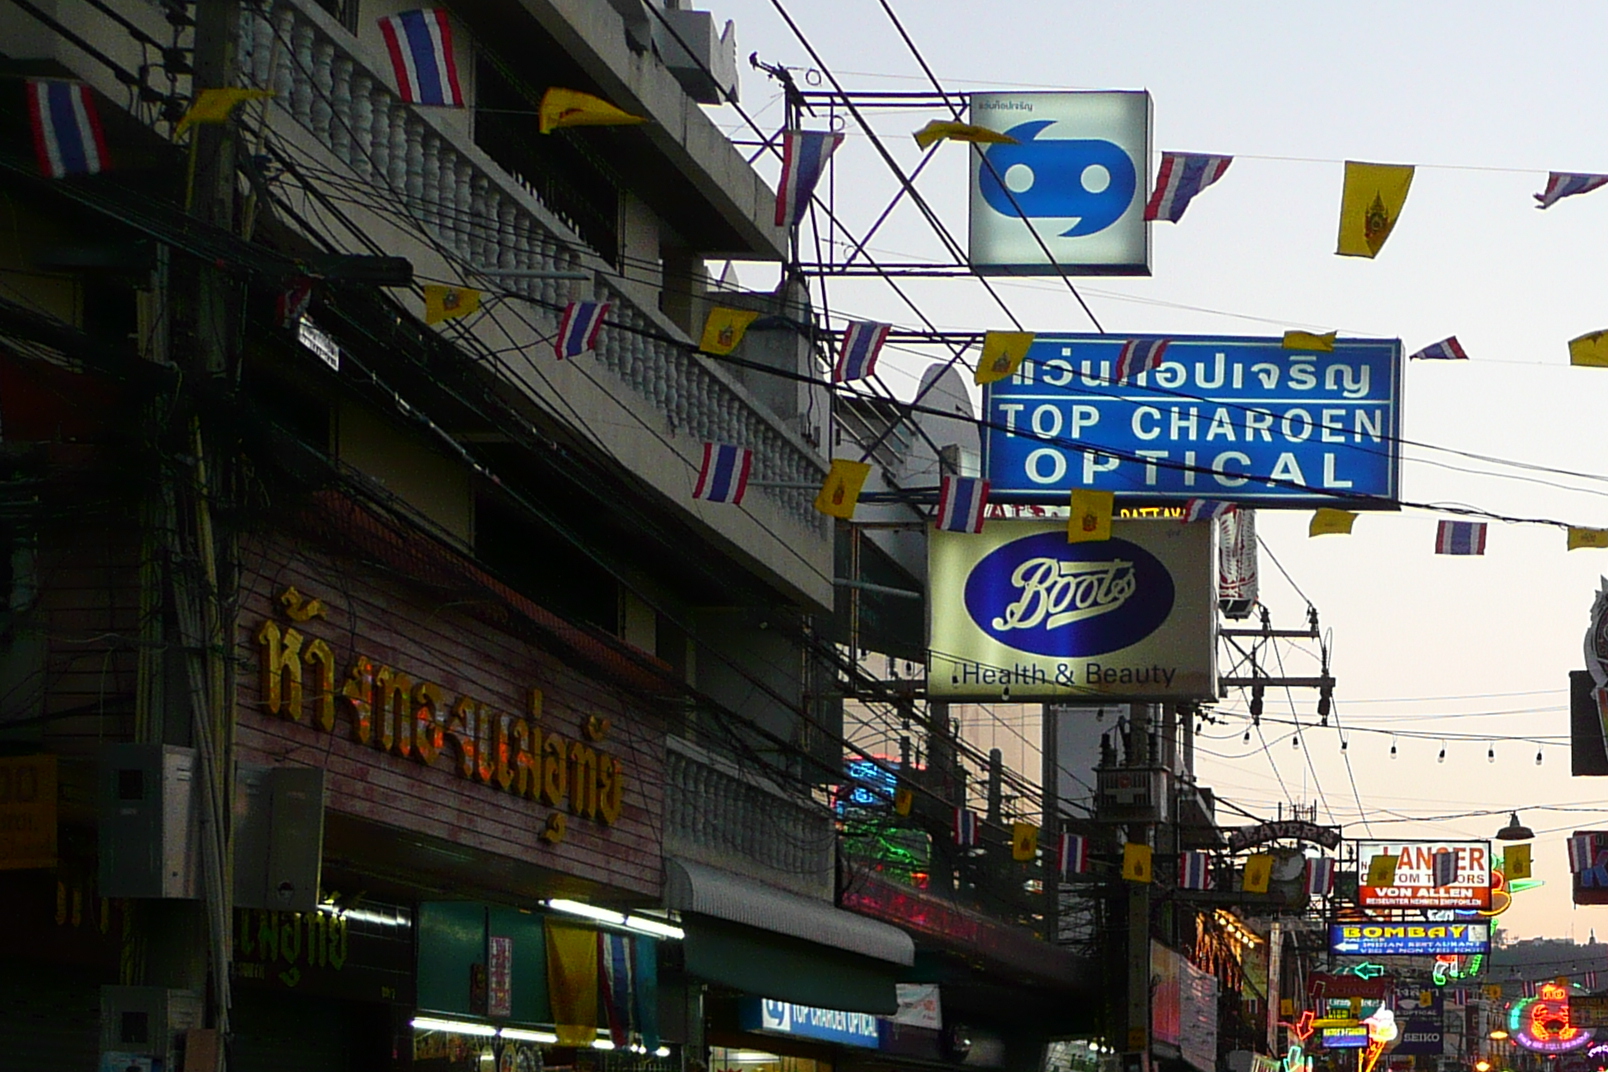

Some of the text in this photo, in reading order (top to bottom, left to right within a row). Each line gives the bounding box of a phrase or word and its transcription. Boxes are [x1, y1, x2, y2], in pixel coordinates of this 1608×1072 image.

[999, 404, 1384, 443] TOP CHAROEN
[1025, 448, 1353, 488] OPTICAL
[992, 557, 1137, 630] Boots
[961, 662, 1176, 687] Health & Beauty
[1375, 887, 1473, 898] VON ALLEN
[1343, 926, 1467, 938] BOMBAY
[1403, 1032, 1440, 1043] SEIKO
